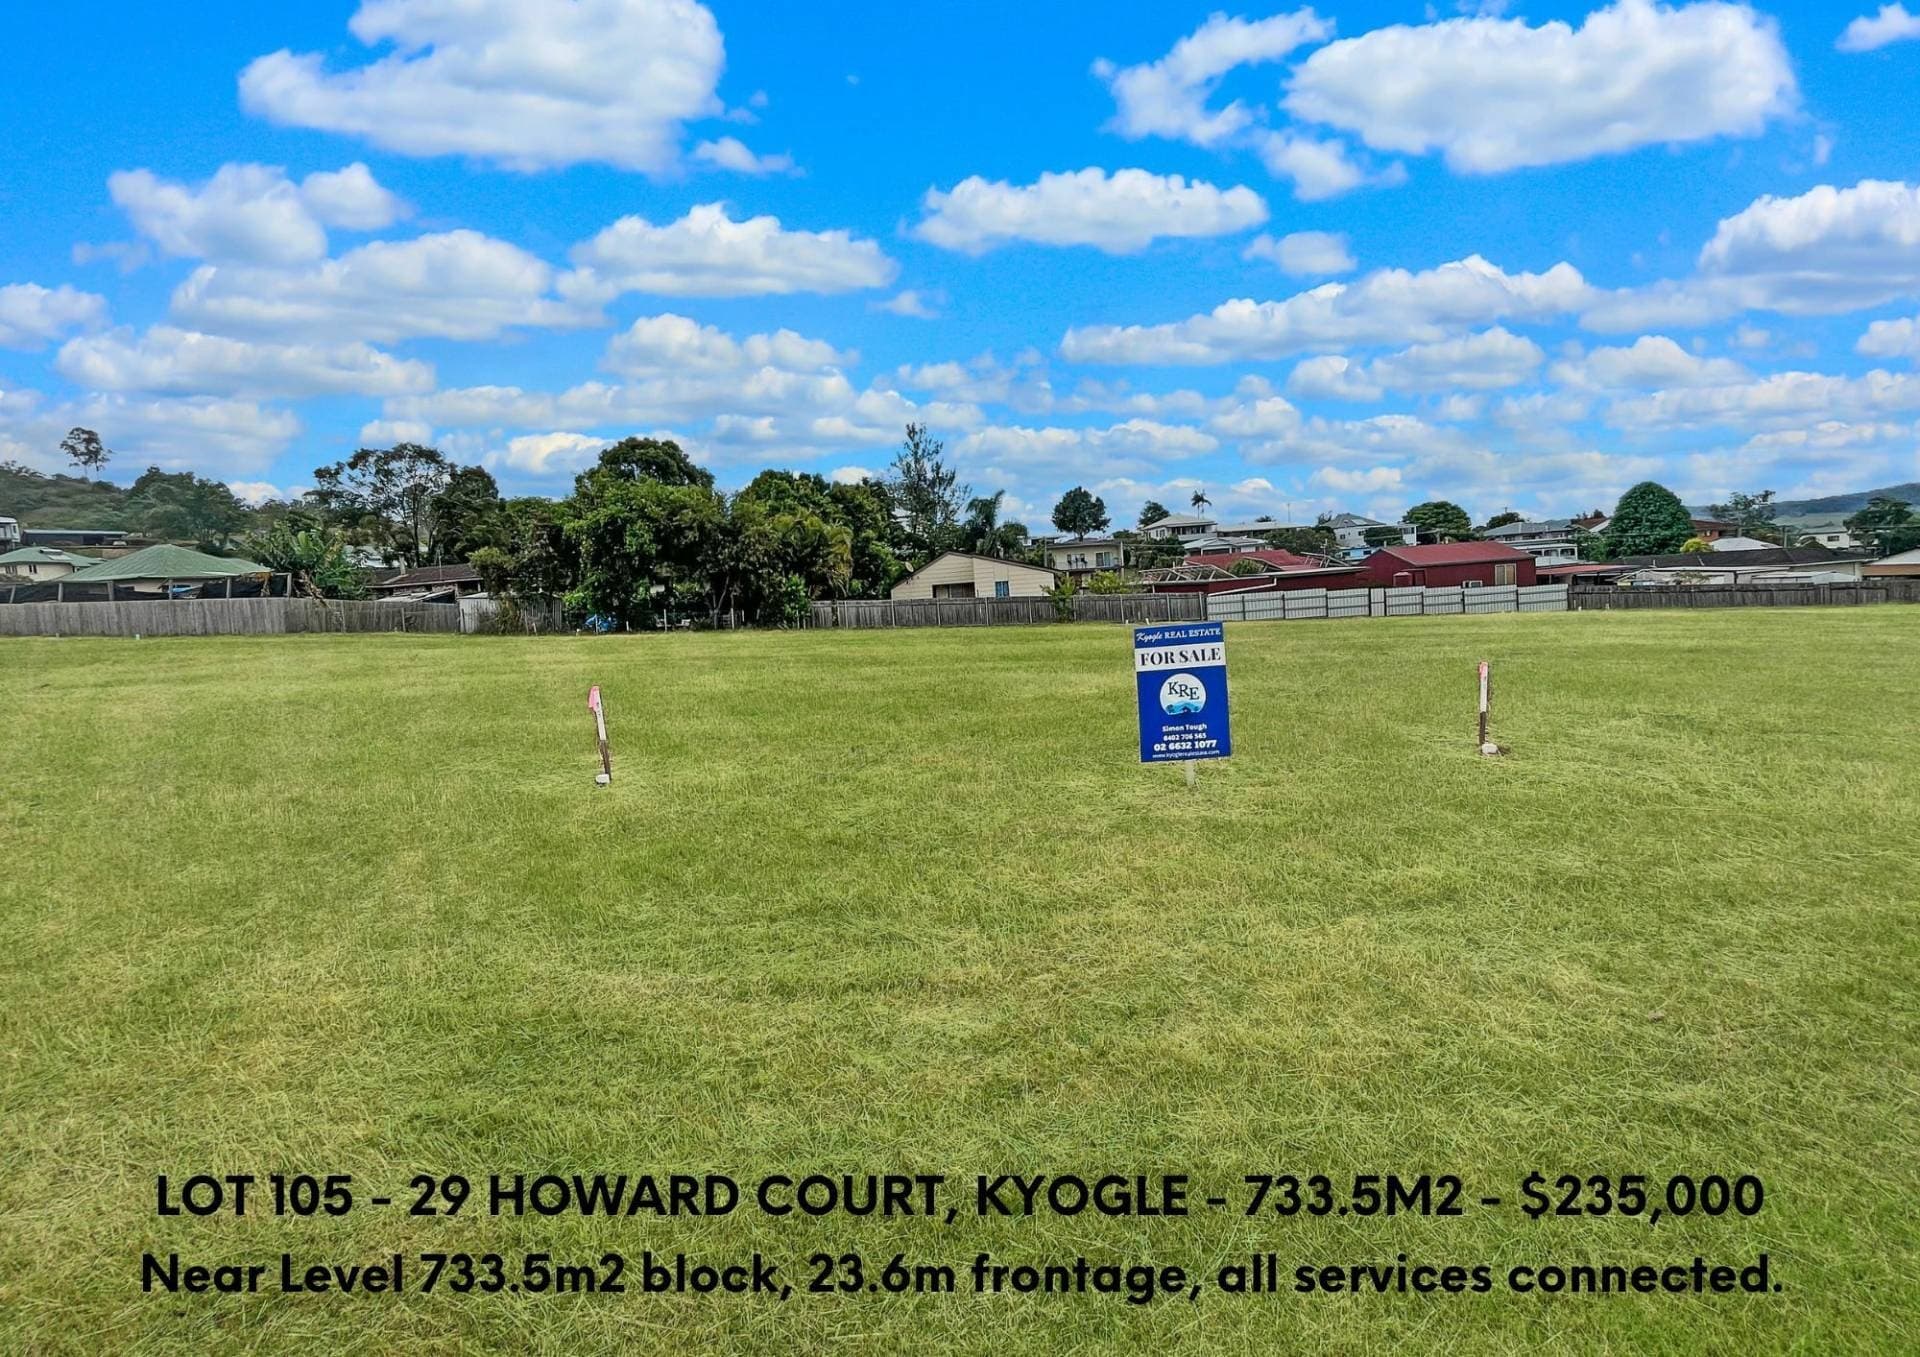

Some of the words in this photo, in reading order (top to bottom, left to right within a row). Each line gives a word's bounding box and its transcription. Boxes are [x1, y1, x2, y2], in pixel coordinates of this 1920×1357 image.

[1136, 632, 1162, 643] Kyogle
[1164, 630, 1187, 639] REAL
[1188, 628, 1221, 637] ESTATE
[1140, 651, 1175, 666] FOR
[1179, 648, 1221, 663] SALE
[1167, 681, 1200, 700] KRE
[1185, 723, 1207, 731] Tough
[1153, 743, 1167, 751] 02
[1168, 741, 1193, 750] 6632
[1194, 739, 1217, 749] 1077
